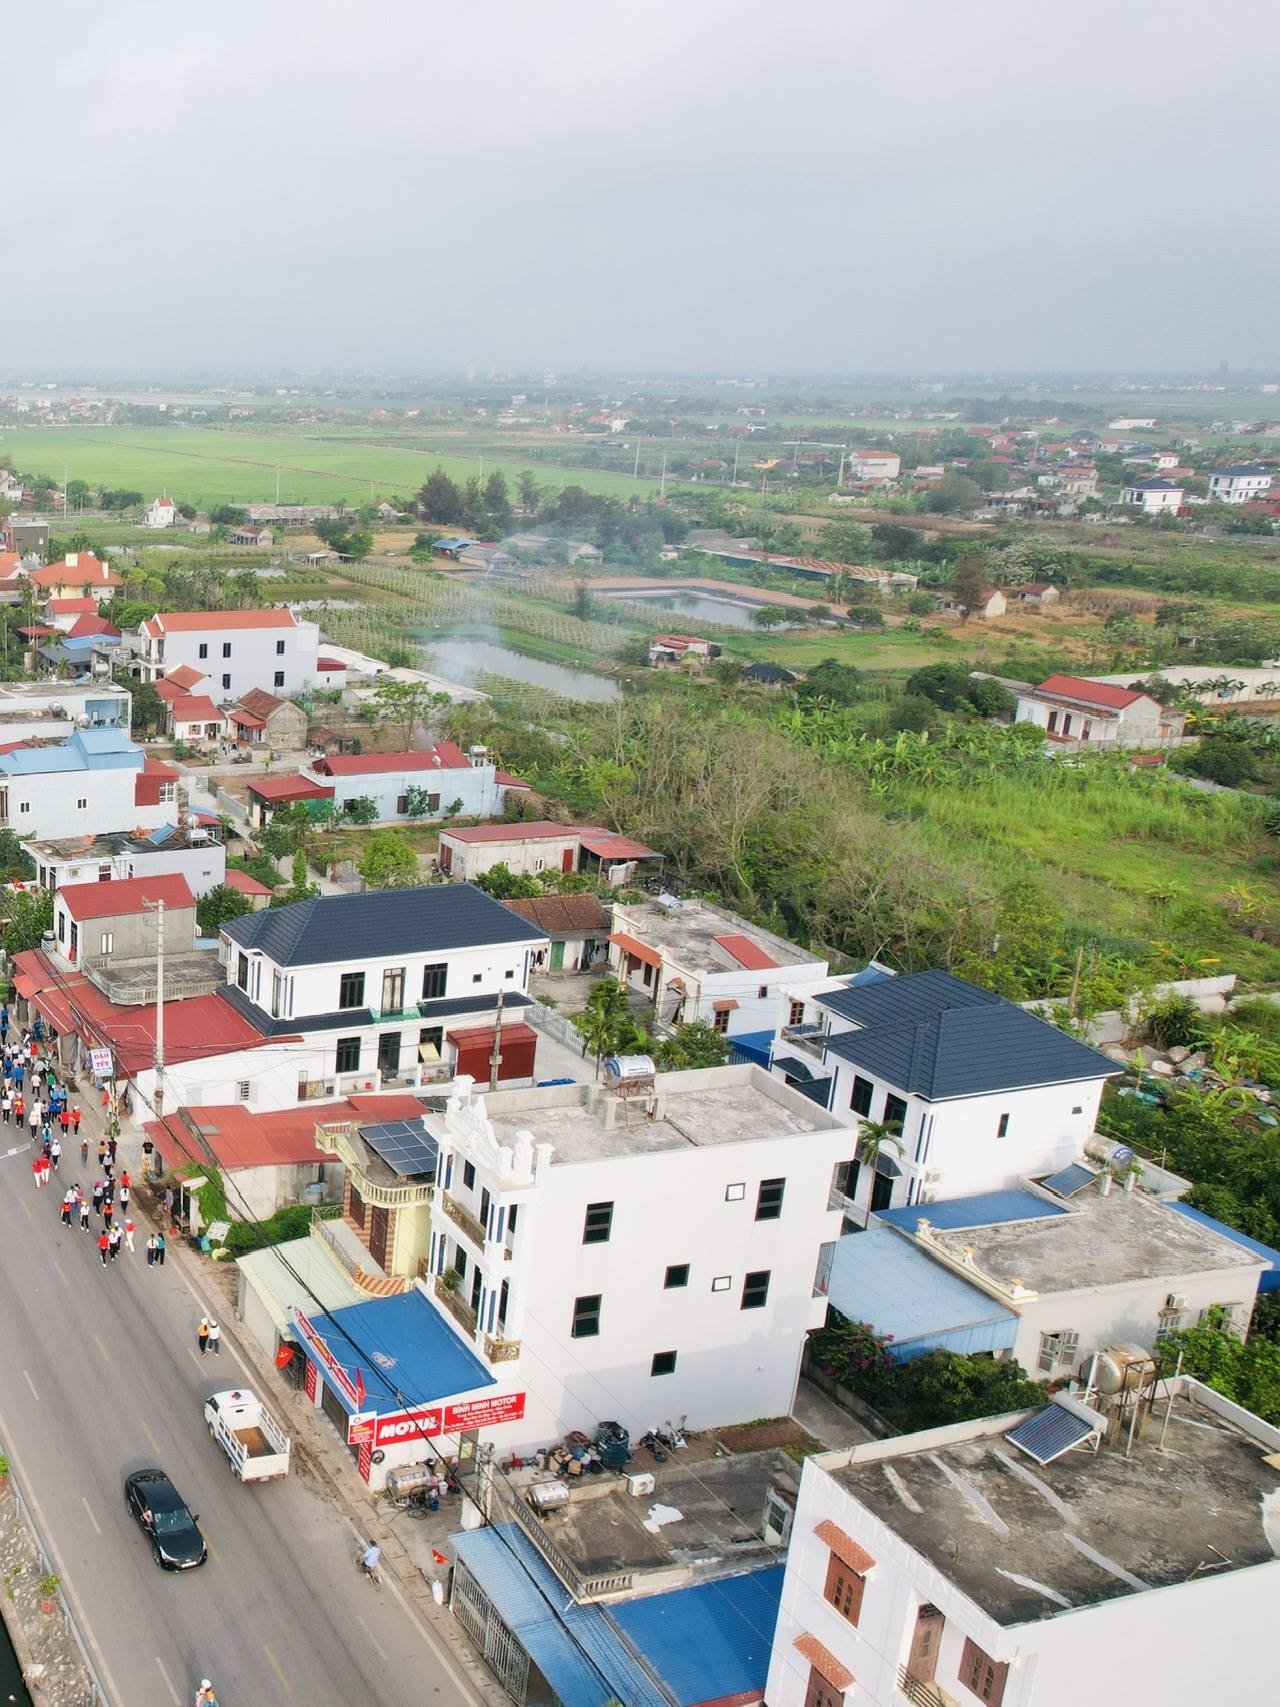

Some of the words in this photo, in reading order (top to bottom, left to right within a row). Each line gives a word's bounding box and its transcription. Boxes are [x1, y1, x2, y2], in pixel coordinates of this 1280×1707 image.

[471, 1401, 490, 1411] MINH
[491, 1396, 517, 1407] MOTOR
[379, 1417, 437, 1439] MOTUL
